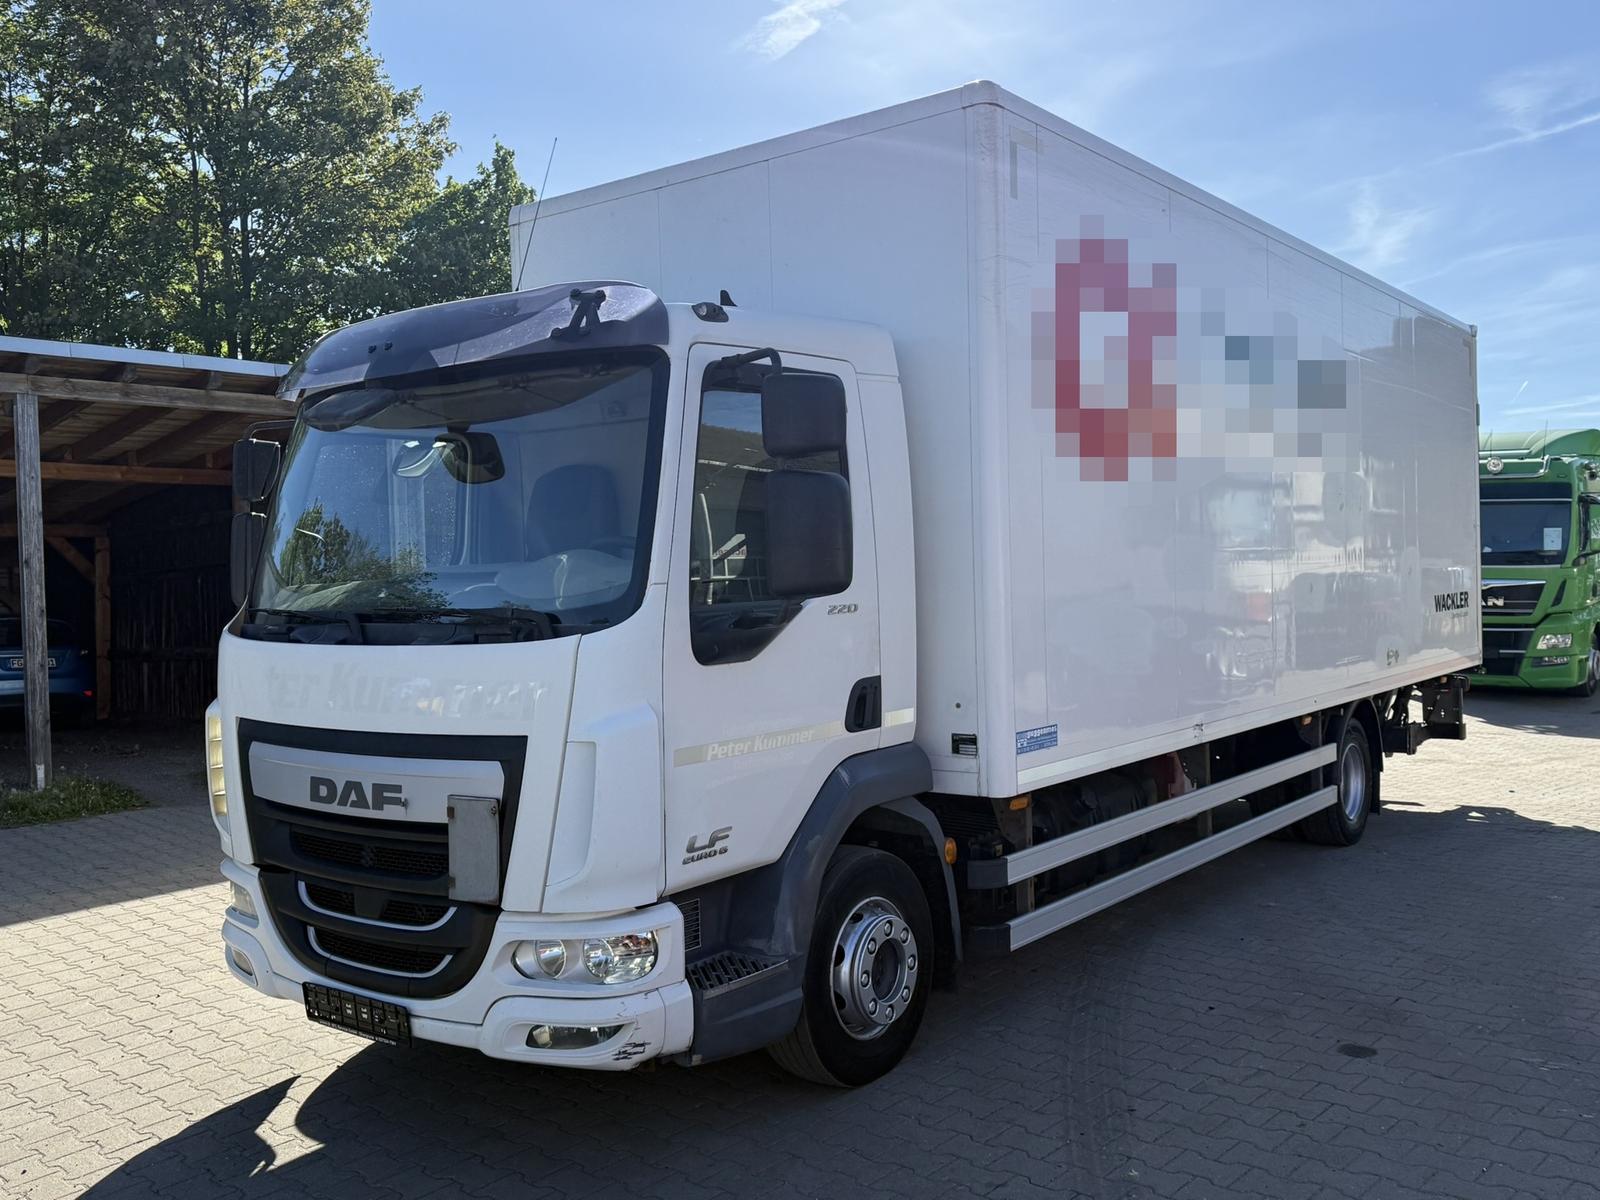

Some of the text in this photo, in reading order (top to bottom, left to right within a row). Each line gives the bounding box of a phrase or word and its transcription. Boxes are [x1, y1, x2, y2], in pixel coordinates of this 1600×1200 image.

[827, 603, 859, 616] 220
[1434, 591, 1469, 613] WACKLER
[707, 742, 752, 761] Peter
[753, 730, 816, 752] Kummer
[310, 776, 402, 811] DAF
[686, 825, 733, 854] LF
